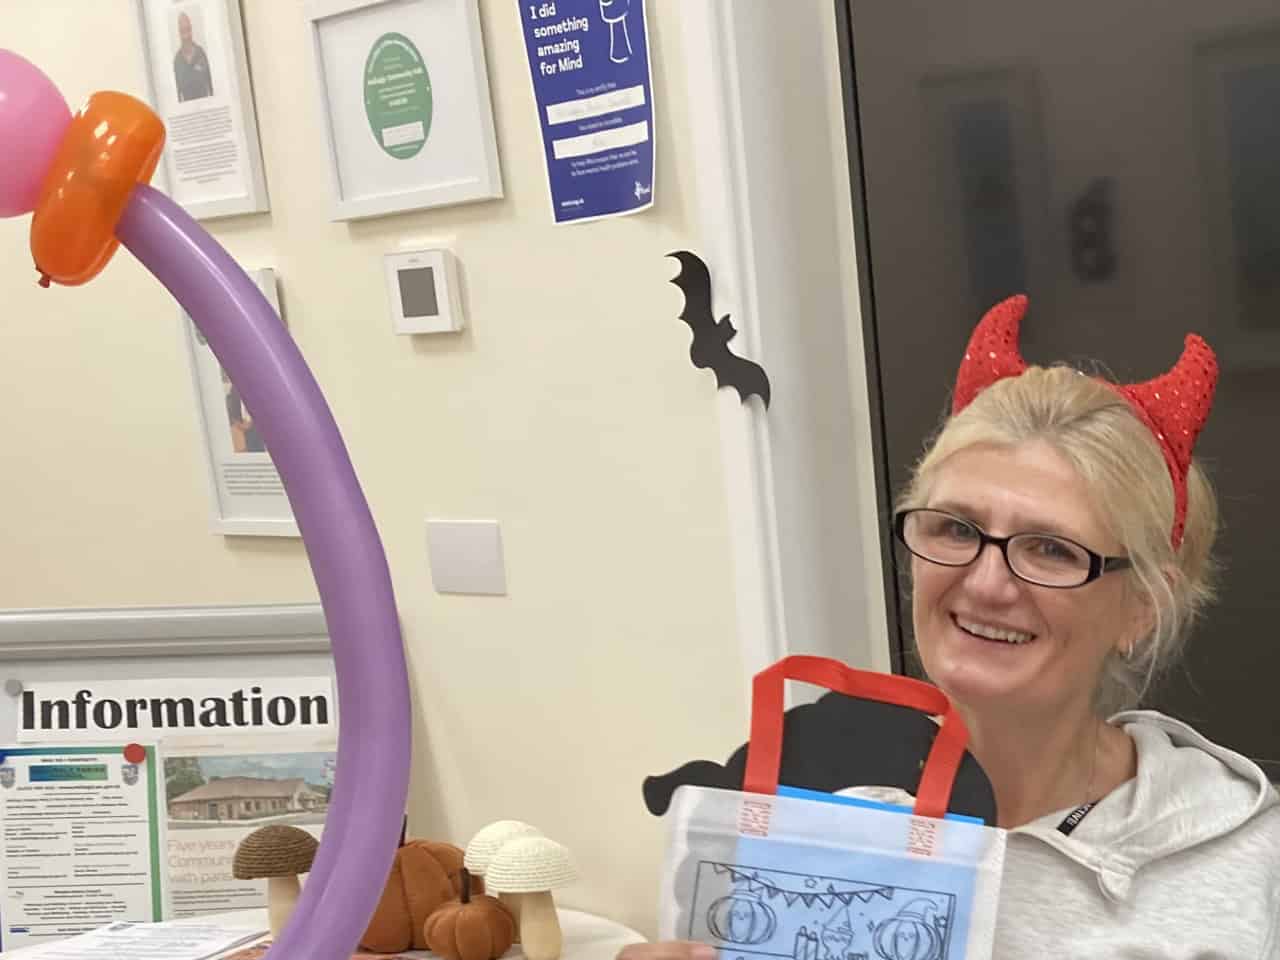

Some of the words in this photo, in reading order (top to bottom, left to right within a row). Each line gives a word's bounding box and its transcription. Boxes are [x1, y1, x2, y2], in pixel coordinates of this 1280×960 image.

[529, 5, 538, 20] I
[538, 2, 557, 18] did
[533, 15, 590, 39] something
[537, 38, 581, 57] amazing
[540, 60, 557, 76] for
[557, 54, 584, 73] Mind
[22, 686, 330, 730] Information
